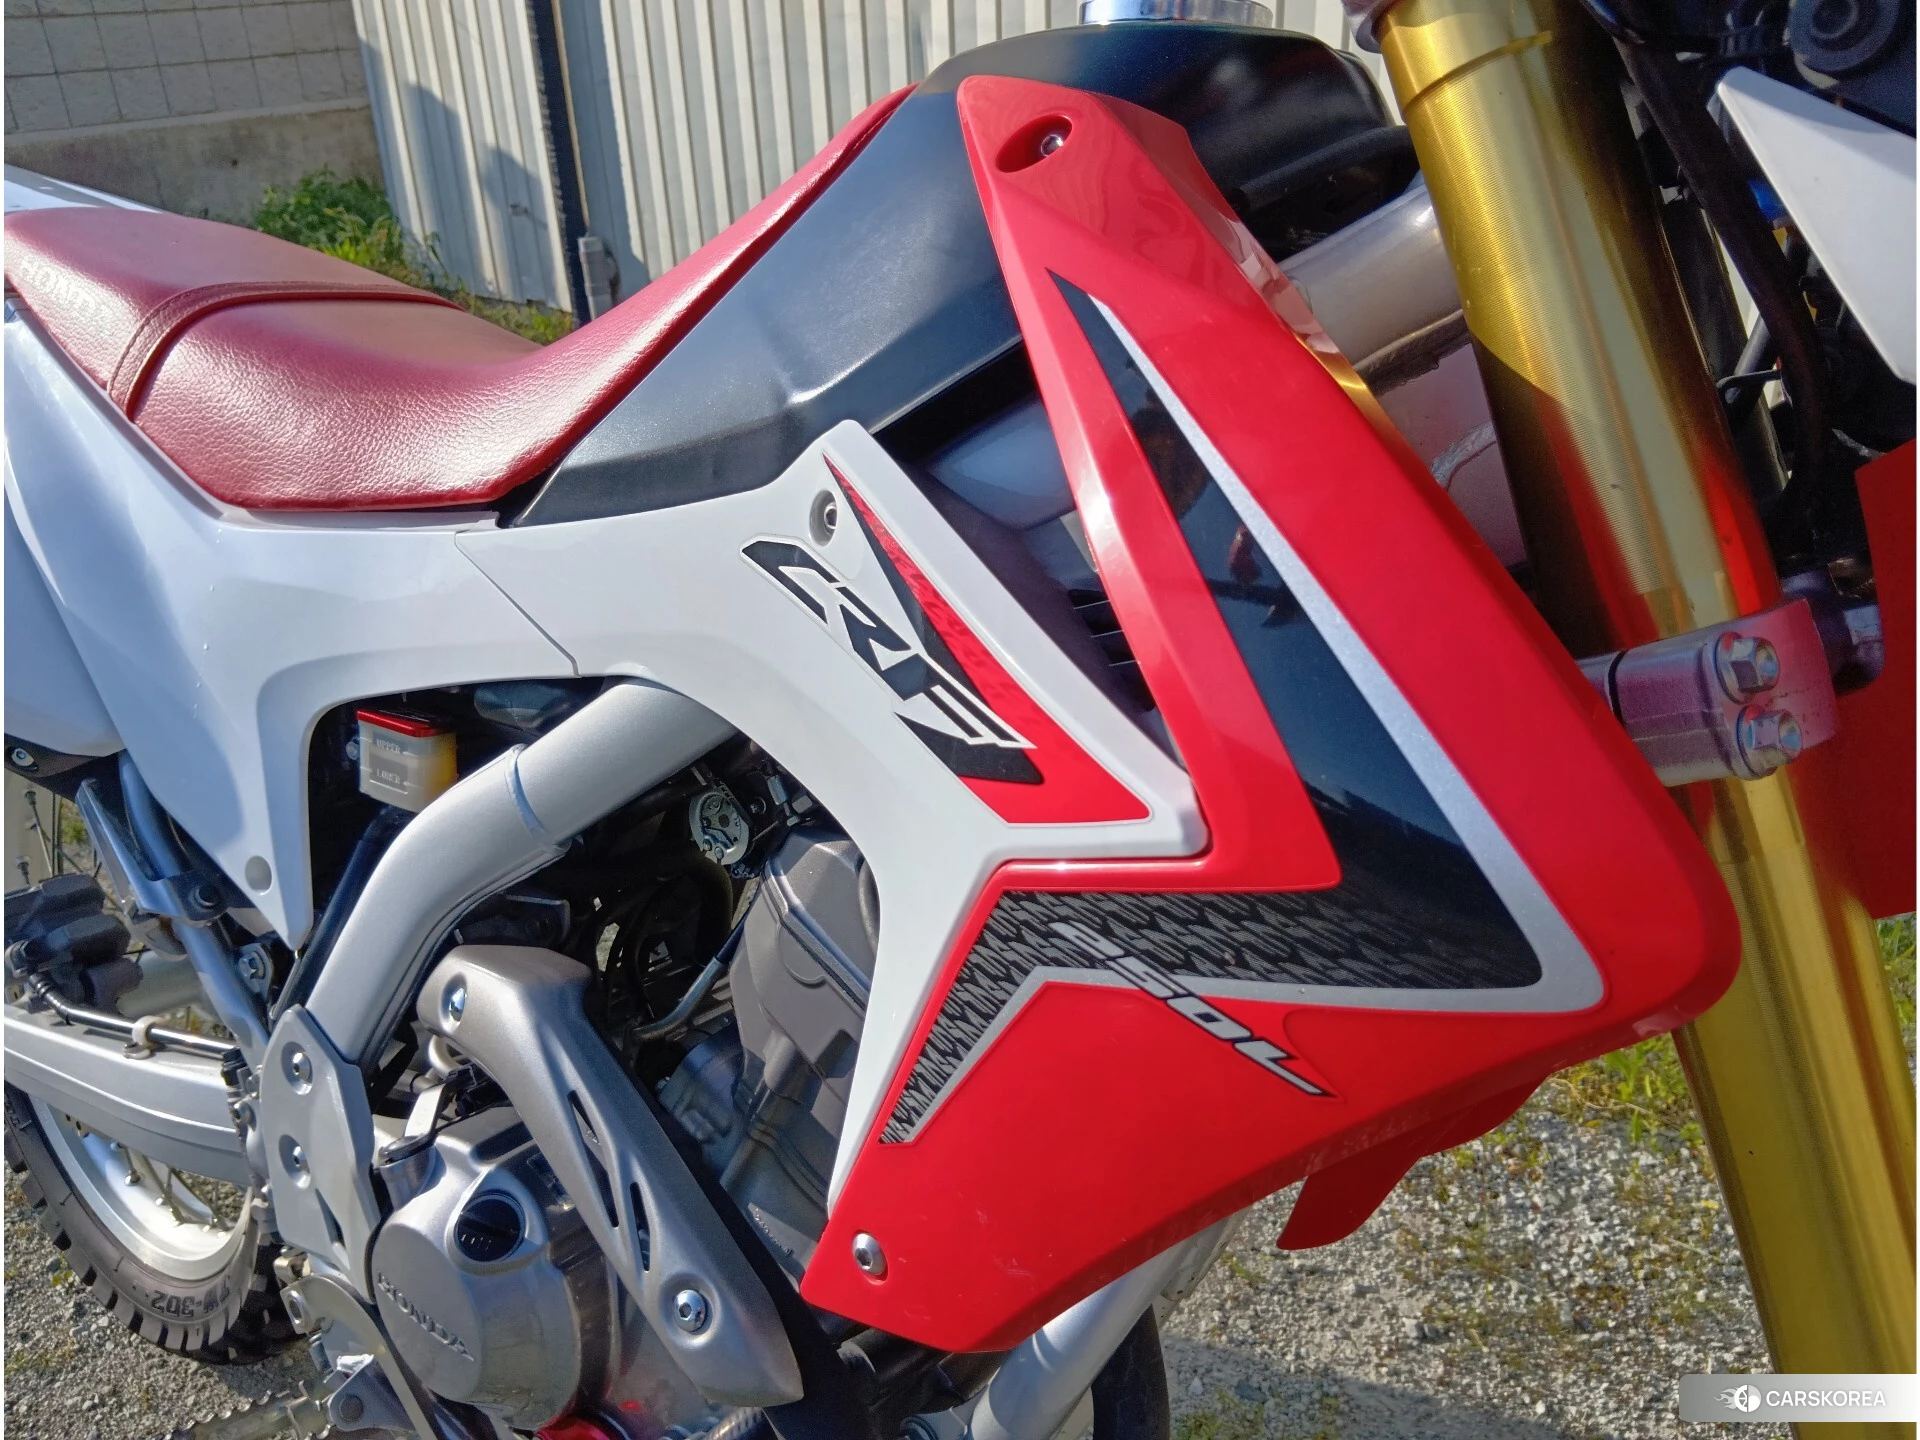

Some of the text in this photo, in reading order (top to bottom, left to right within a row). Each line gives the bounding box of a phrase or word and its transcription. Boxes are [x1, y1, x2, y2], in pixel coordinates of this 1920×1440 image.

[740, 538, 1024, 744] CRF
[376, 739, 401, 754] UPPER
[376, 768, 401, 784] LOWER
[1048, 920, 1326, 1093] 250L
[377, 1272, 474, 1361] HONDA
